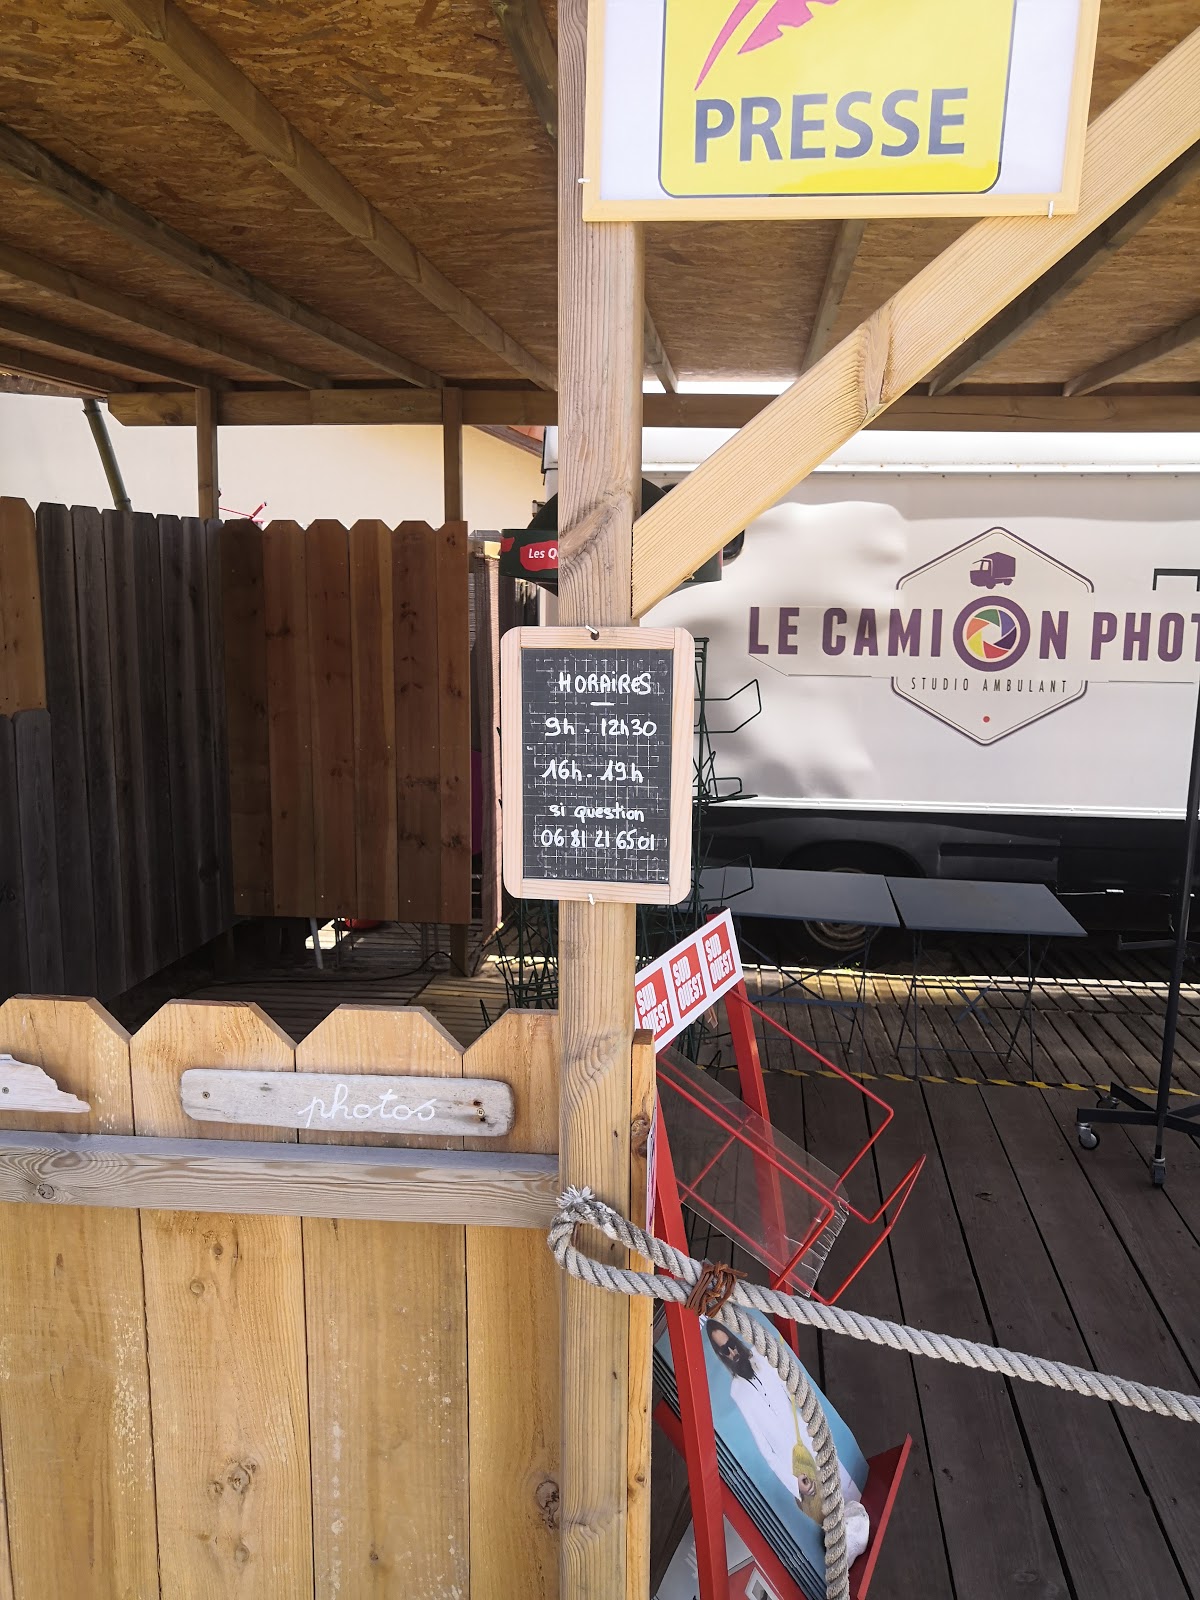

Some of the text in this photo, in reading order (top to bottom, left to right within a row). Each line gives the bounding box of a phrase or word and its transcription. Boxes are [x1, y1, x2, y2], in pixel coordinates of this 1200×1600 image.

[695, 87, 968, 164] PRESSE
[528, 547, 559, 560] Les Q
[748, 606, 800, 655] LE
[911, 677, 1067, 693] STUDIO AMBULANT
[544, 717, 575, 737] 9h
[601, 718, 657, 737] 12h30
[541, 759, 582, 781] 16h
[549, 802, 645, 824] si question
[541, 828, 565, 847] 06
[570, 829, 586, 848] 81
[594, 829, 610, 848] 21
[705, 933, 722, 962] SUD
[672, 955, 692, 987] SUD
[709, 948, 734, 985] OUEST
[636, 981, 657, 1016] SUD
[677, 974, 704, 1012] OUEST
[297, 1083, 438, 1128] photos
